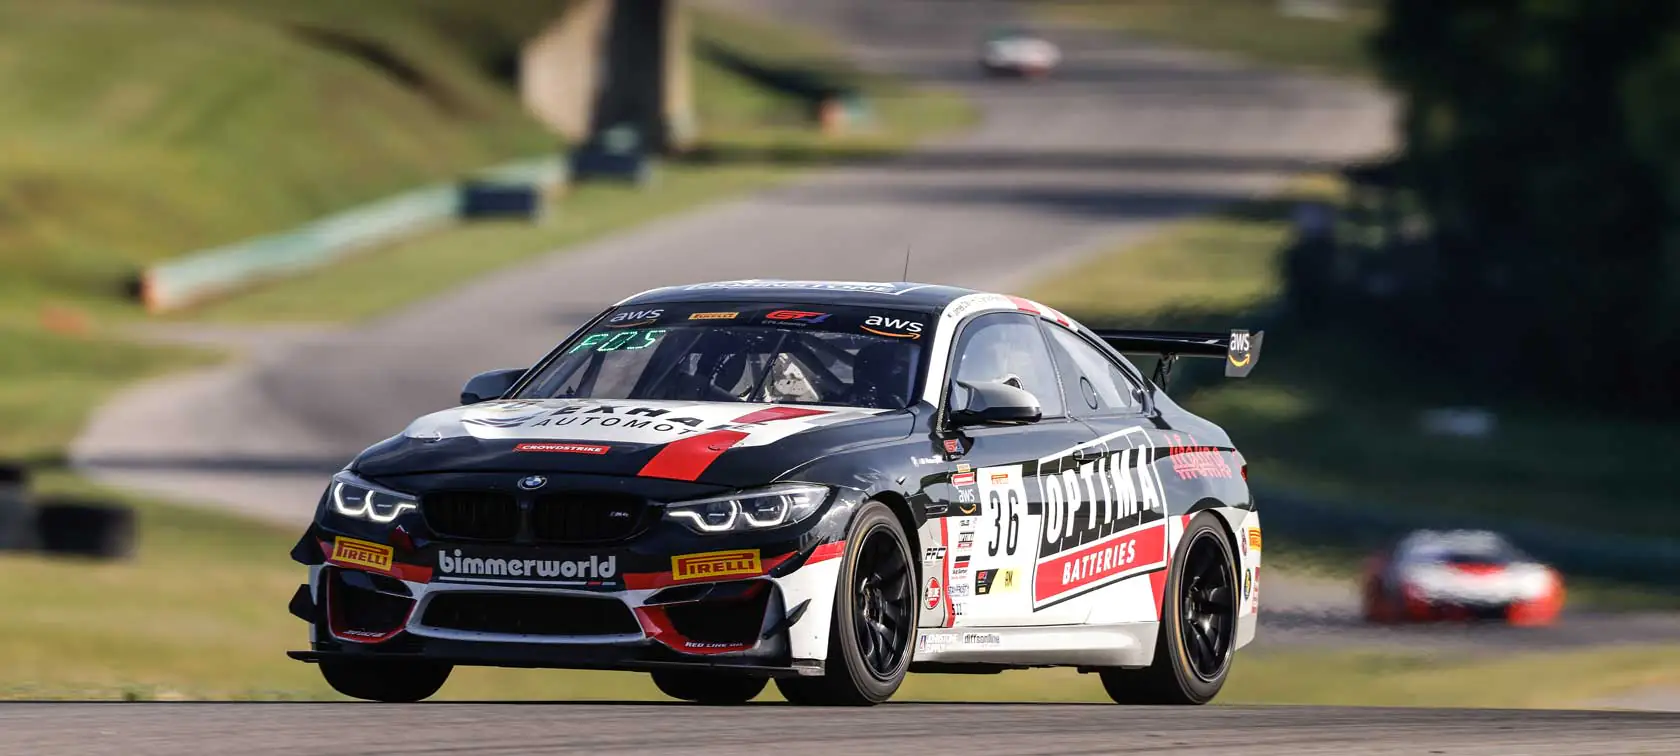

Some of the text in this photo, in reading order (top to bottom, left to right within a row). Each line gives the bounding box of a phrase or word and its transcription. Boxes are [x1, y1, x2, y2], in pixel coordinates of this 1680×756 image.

[610, 309, 665, 323] aws
[765, 310, 832, 324] GT4
[865, 315, 924, 332] aws
[1230, 333, 1249, 351] aws
[522, 444, 603, 453] CROWDSTRIKE
[959, 488, 975, 503] aws
[1046, 443, 1160, 544] OPTIMA
[987, 488, 1019, 556] 36
[336, 540, 389, 566] PIRELLI
[926, 547, 946, 560] PFC
[1062, 539, 1136, 585] BATTERIES
[439, 549, 616, 578] bimmerworld
[678, 552, 754, 576] PIRELLI
